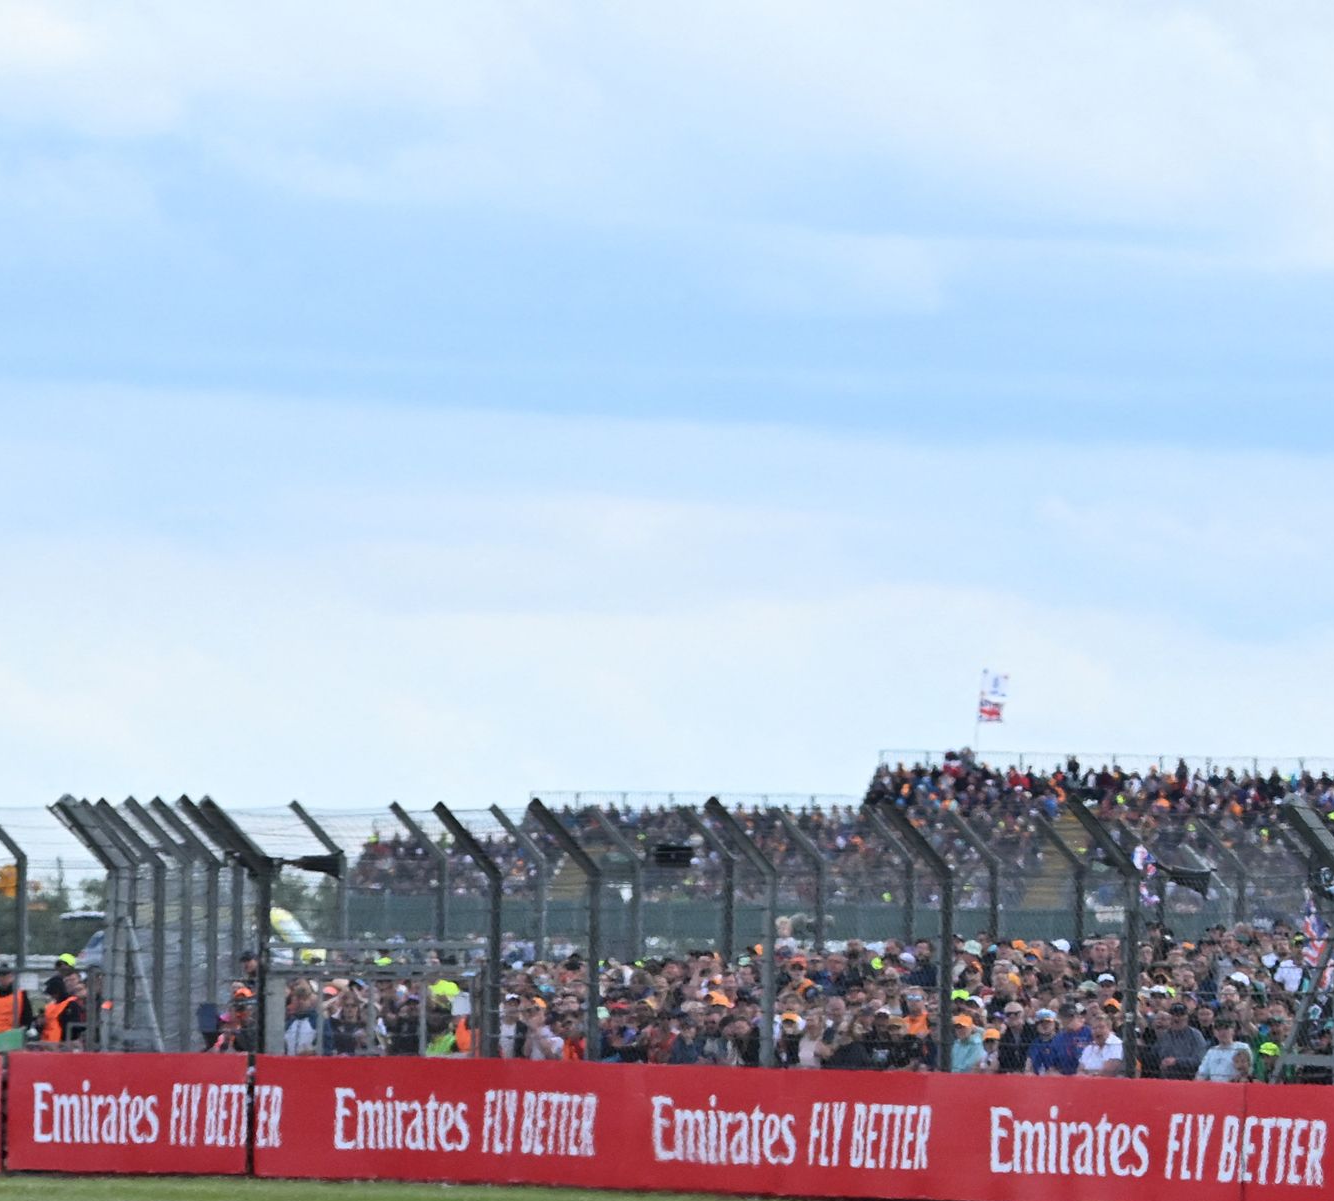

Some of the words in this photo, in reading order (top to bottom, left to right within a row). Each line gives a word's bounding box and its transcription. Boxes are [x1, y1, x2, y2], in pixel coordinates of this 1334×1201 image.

[33, 1079, 160, 1144] Emirates
[169, 1083, 203, 1147] FLY
[334, 1086, 470, 1152] Emirates
[481, 1089, 519, 1154] FLY
[520, 1090, 598, 1157] BETTER
[651, 1094, 797, 1165] Emirates
[808, 1101, 848, 1168] FLY
[849, 1102, 932, 1170] BETTER
[990, 1105, 1151, 1178] Emirates
[1164, 1112, 1216, 1181] FLY
[1217, 1115, 1328, 1187] BETTER
